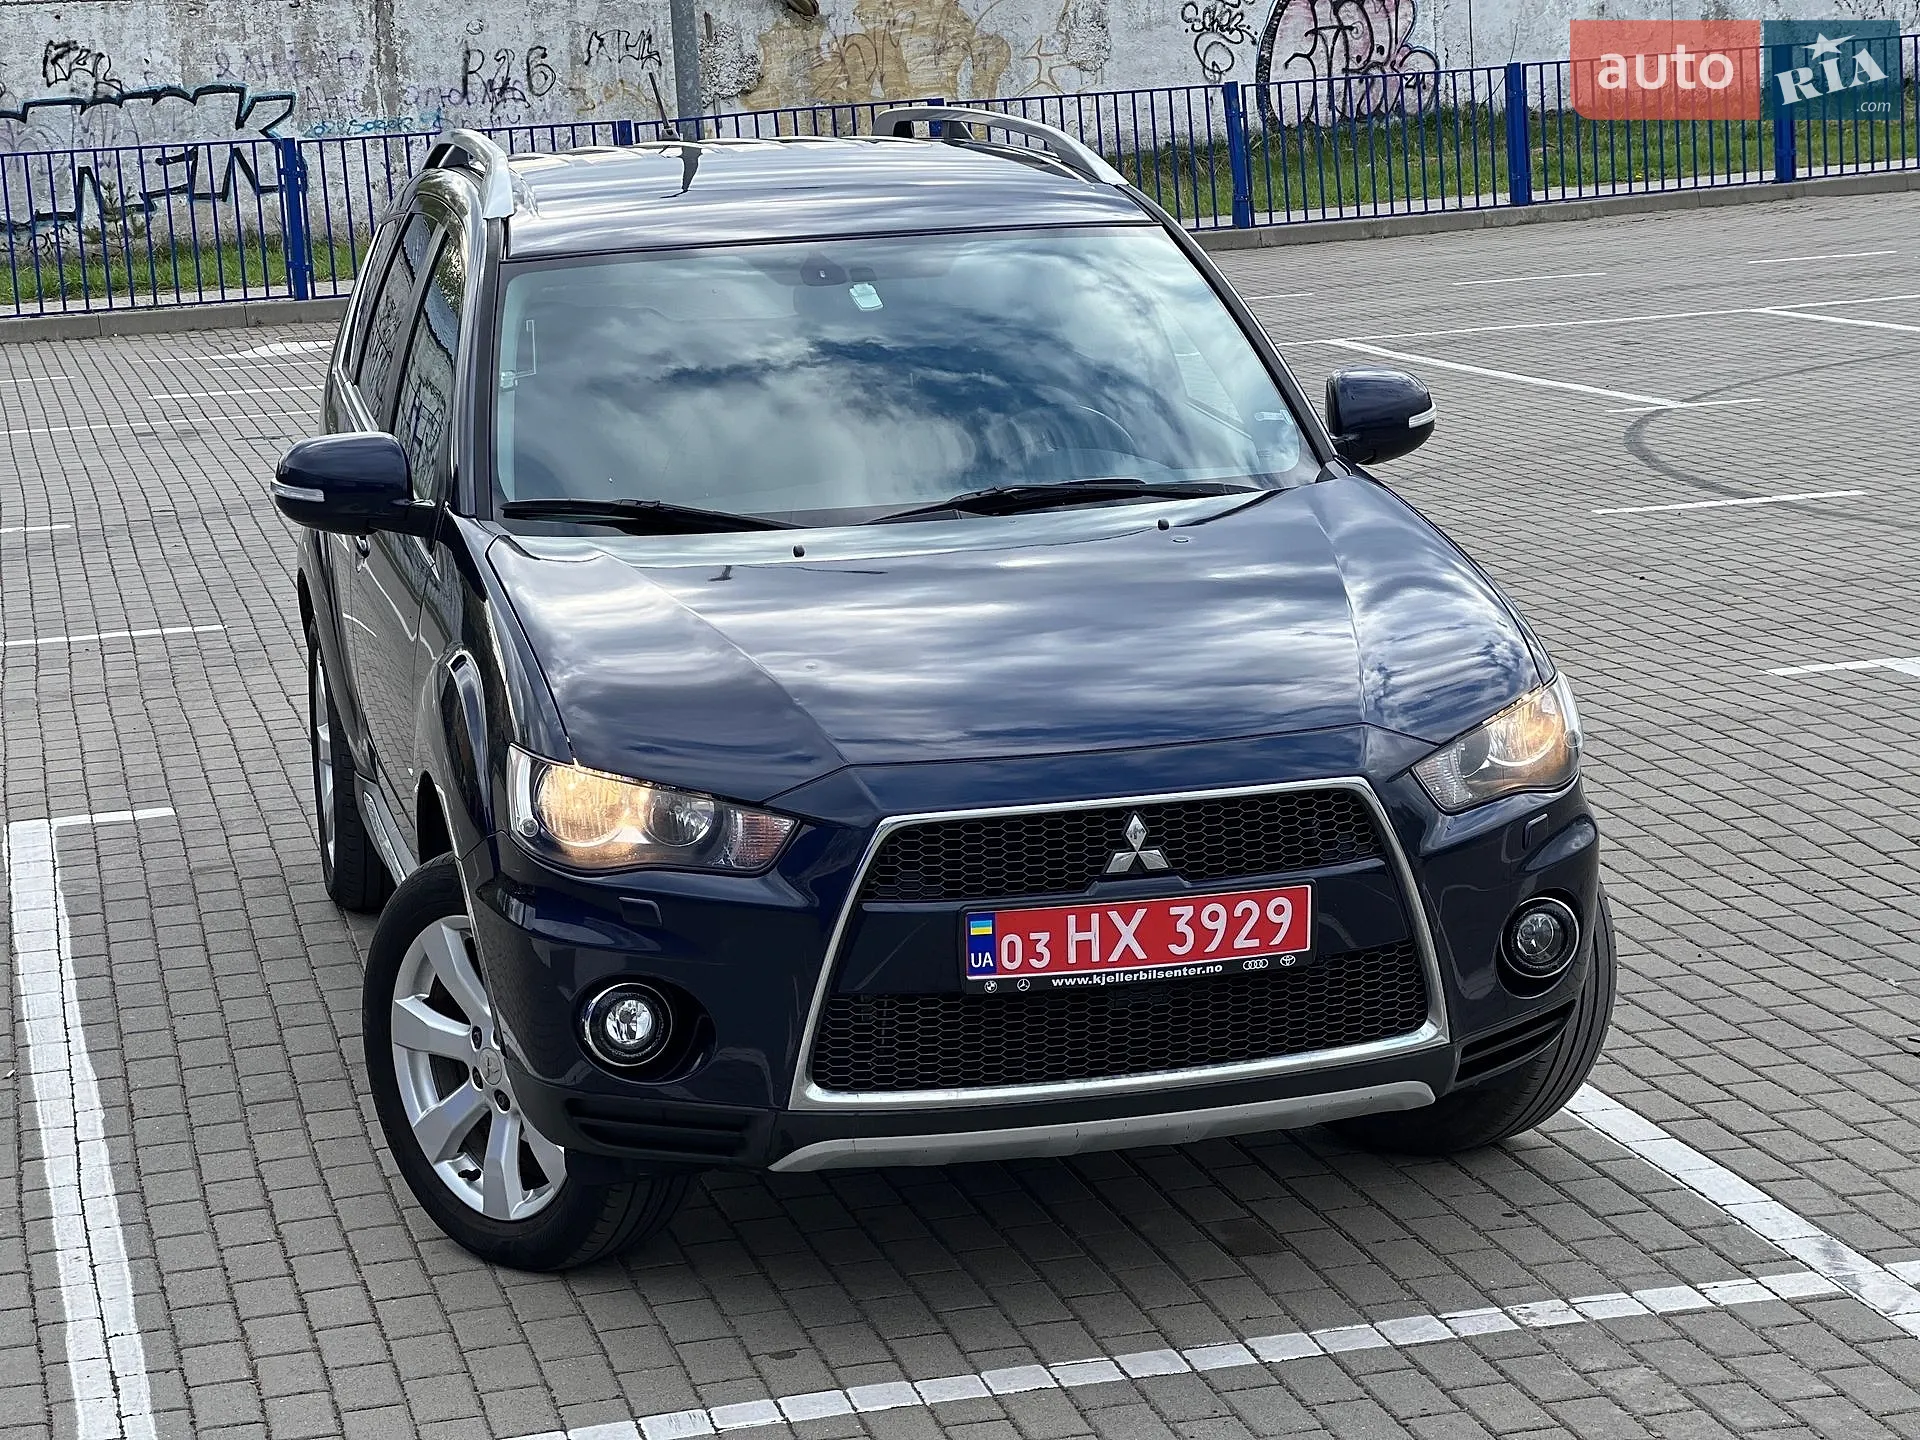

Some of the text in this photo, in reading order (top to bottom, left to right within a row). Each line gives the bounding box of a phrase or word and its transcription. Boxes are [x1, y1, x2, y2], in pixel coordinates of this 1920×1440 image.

[1000, 896, 1294, 970] 03 HX 3929
[970, 953, 993, 969] UA
[1051, 962, 1223, 988] www.kjellerbilsenter.no
